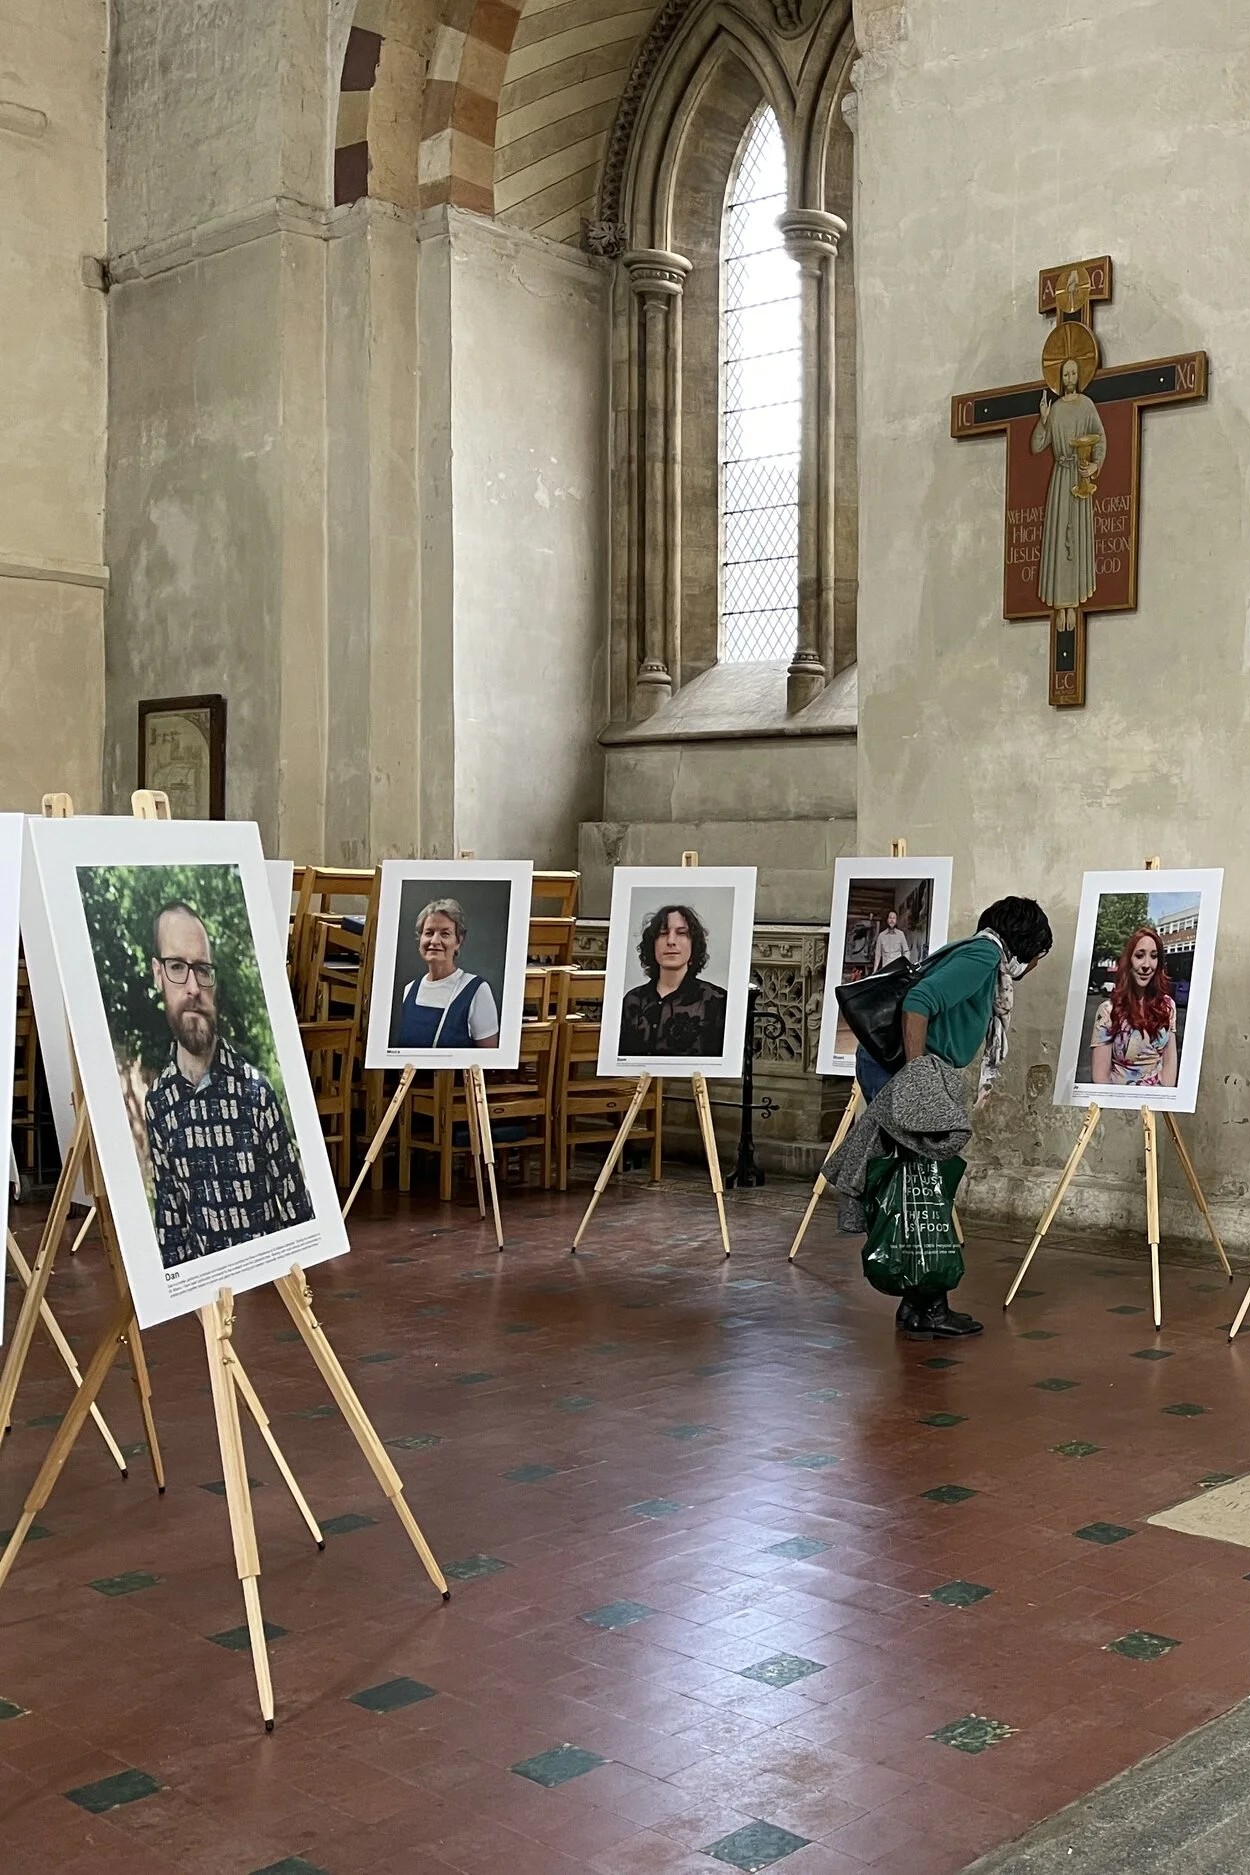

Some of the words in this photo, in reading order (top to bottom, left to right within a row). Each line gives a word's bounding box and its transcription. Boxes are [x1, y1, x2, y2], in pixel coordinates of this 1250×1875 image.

[1090, 269, 1104, 289] Ω
[1094, 515, 1128, 533] PRIEST
[1007, 545, 1041, 565] JESUS
[1021, 565, 1037, 582] OF
[1095, 556, 1121, 575] GOD
[920, 1223, 950, 1232] FOOD
[165, 1271, 180, 1282] Dan
